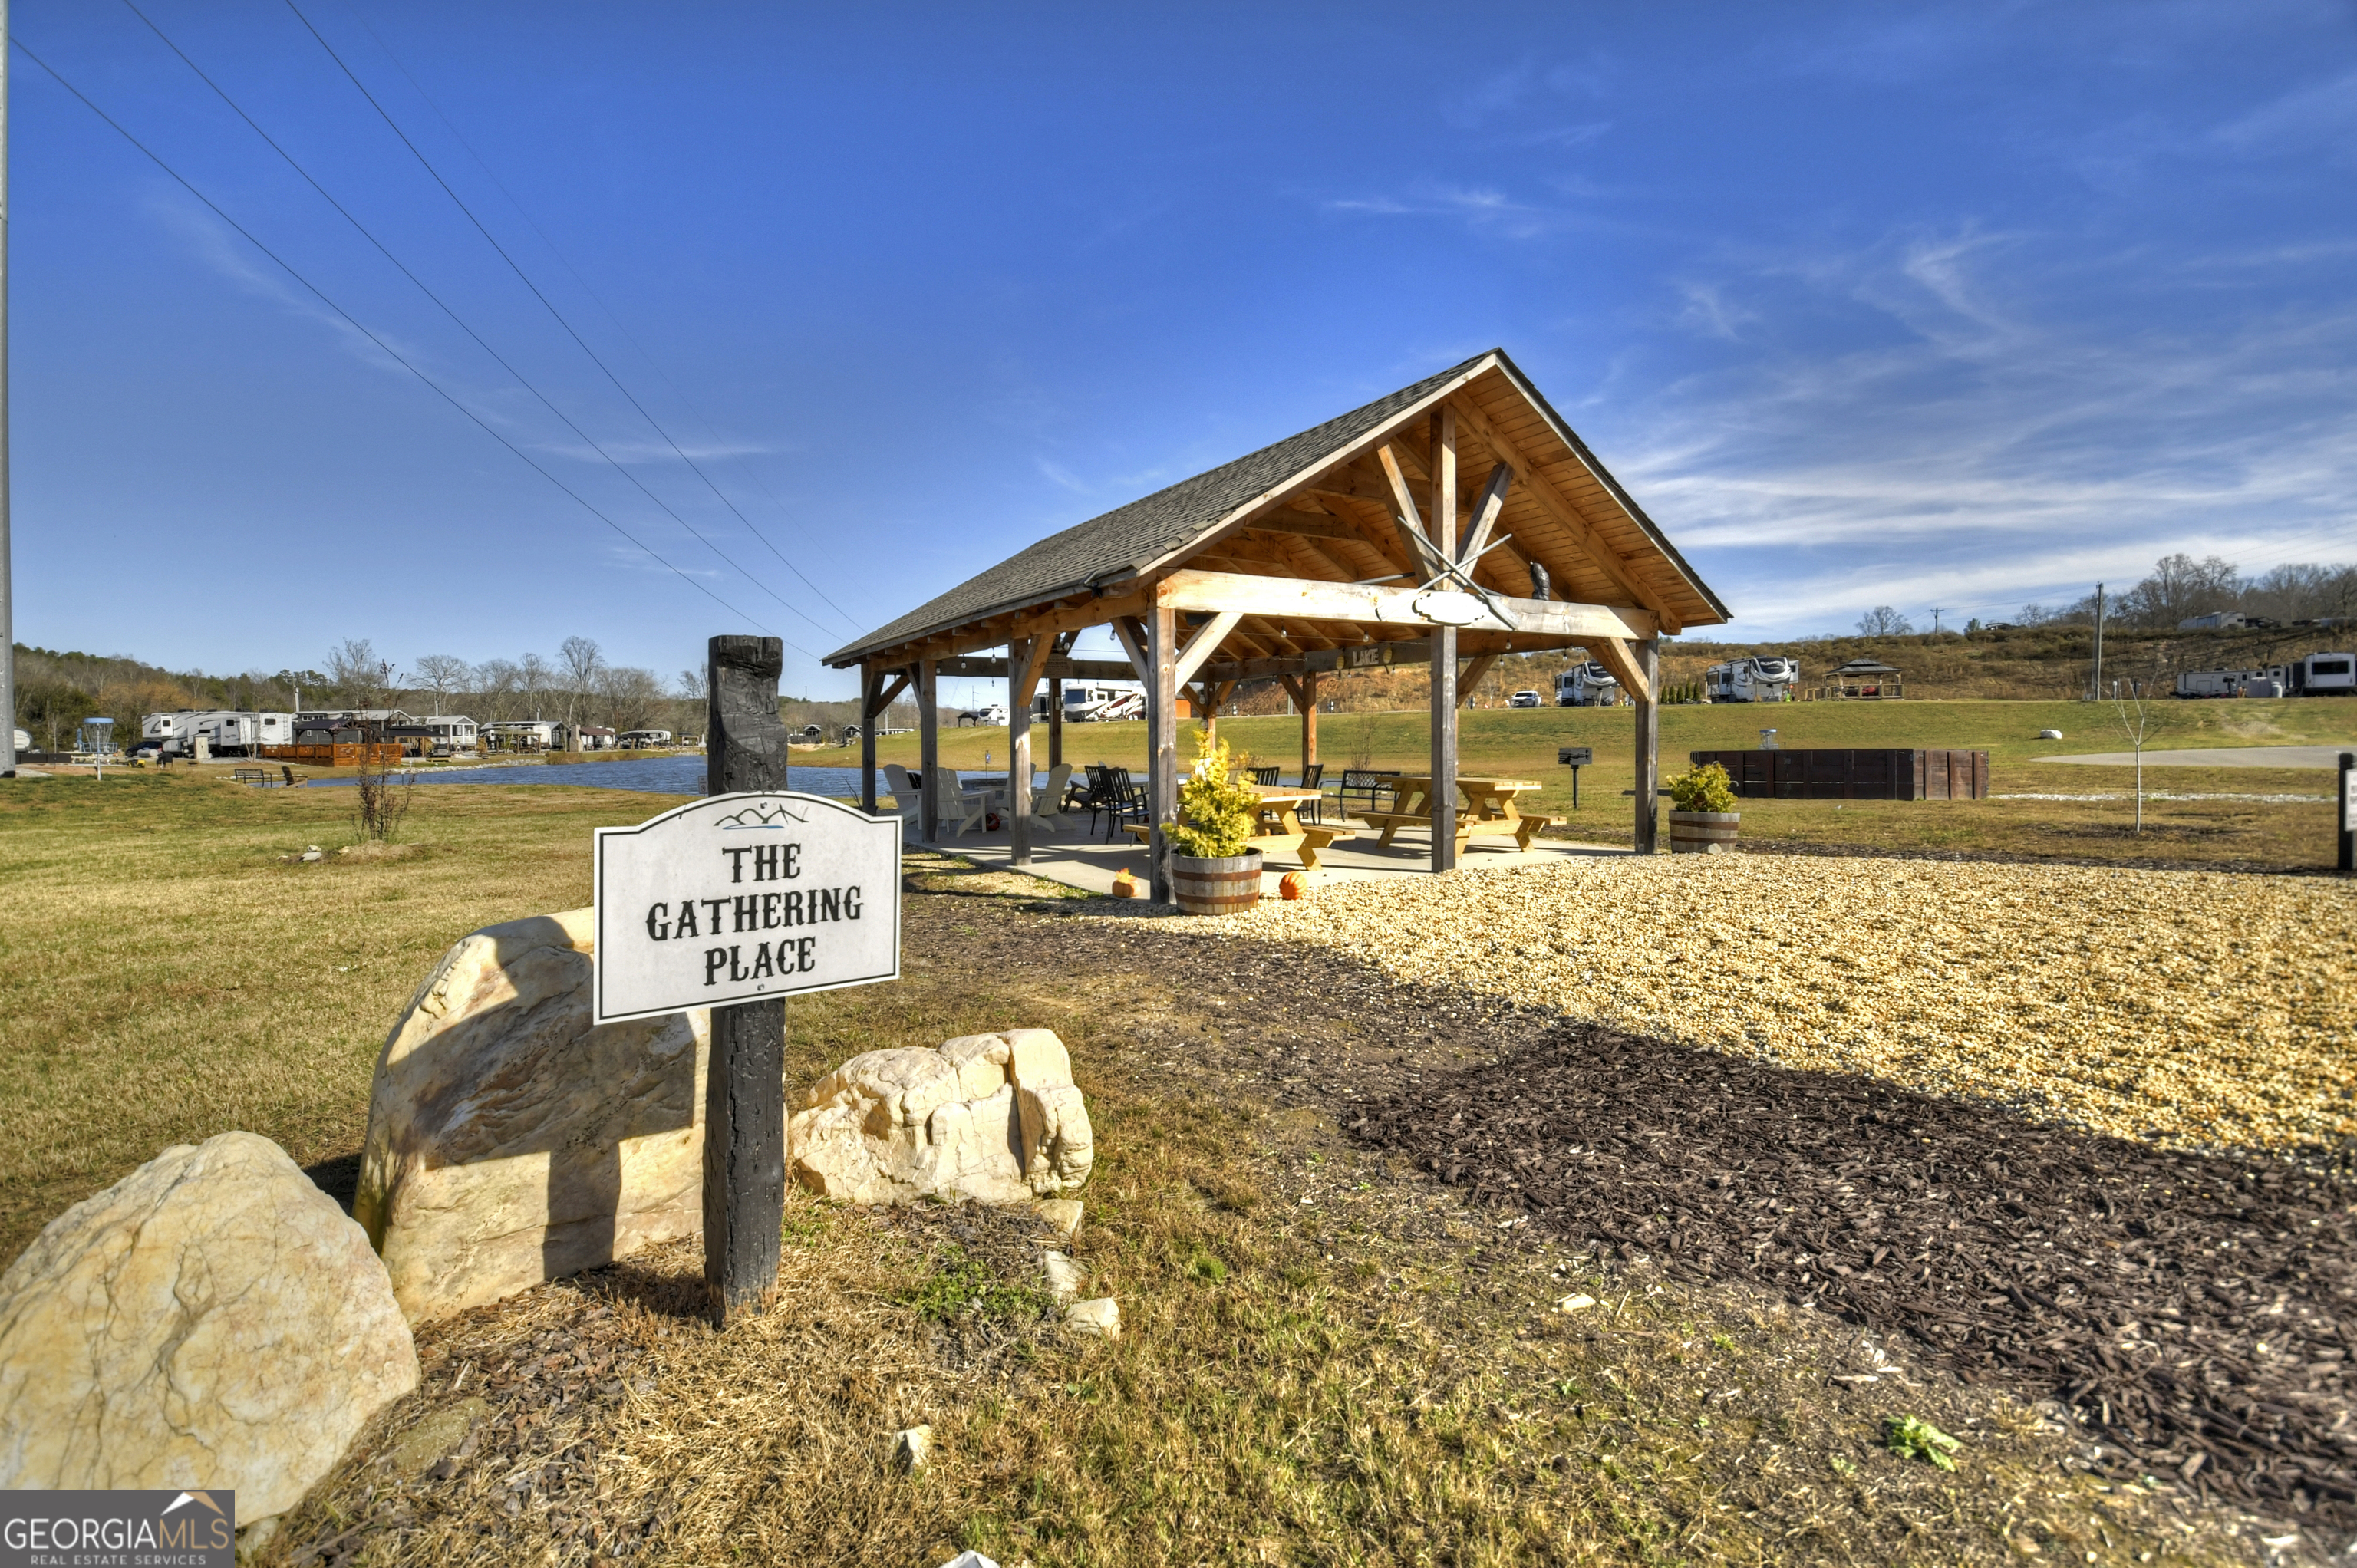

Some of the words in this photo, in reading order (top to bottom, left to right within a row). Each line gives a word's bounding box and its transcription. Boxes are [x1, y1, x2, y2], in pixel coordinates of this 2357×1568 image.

[1352, 647, 1380, 667] LAKE
[722, 843, 801, 884] THE
[645, 885, 864, 941] GATHERING
[704, 937, 816, 987] PLACE
